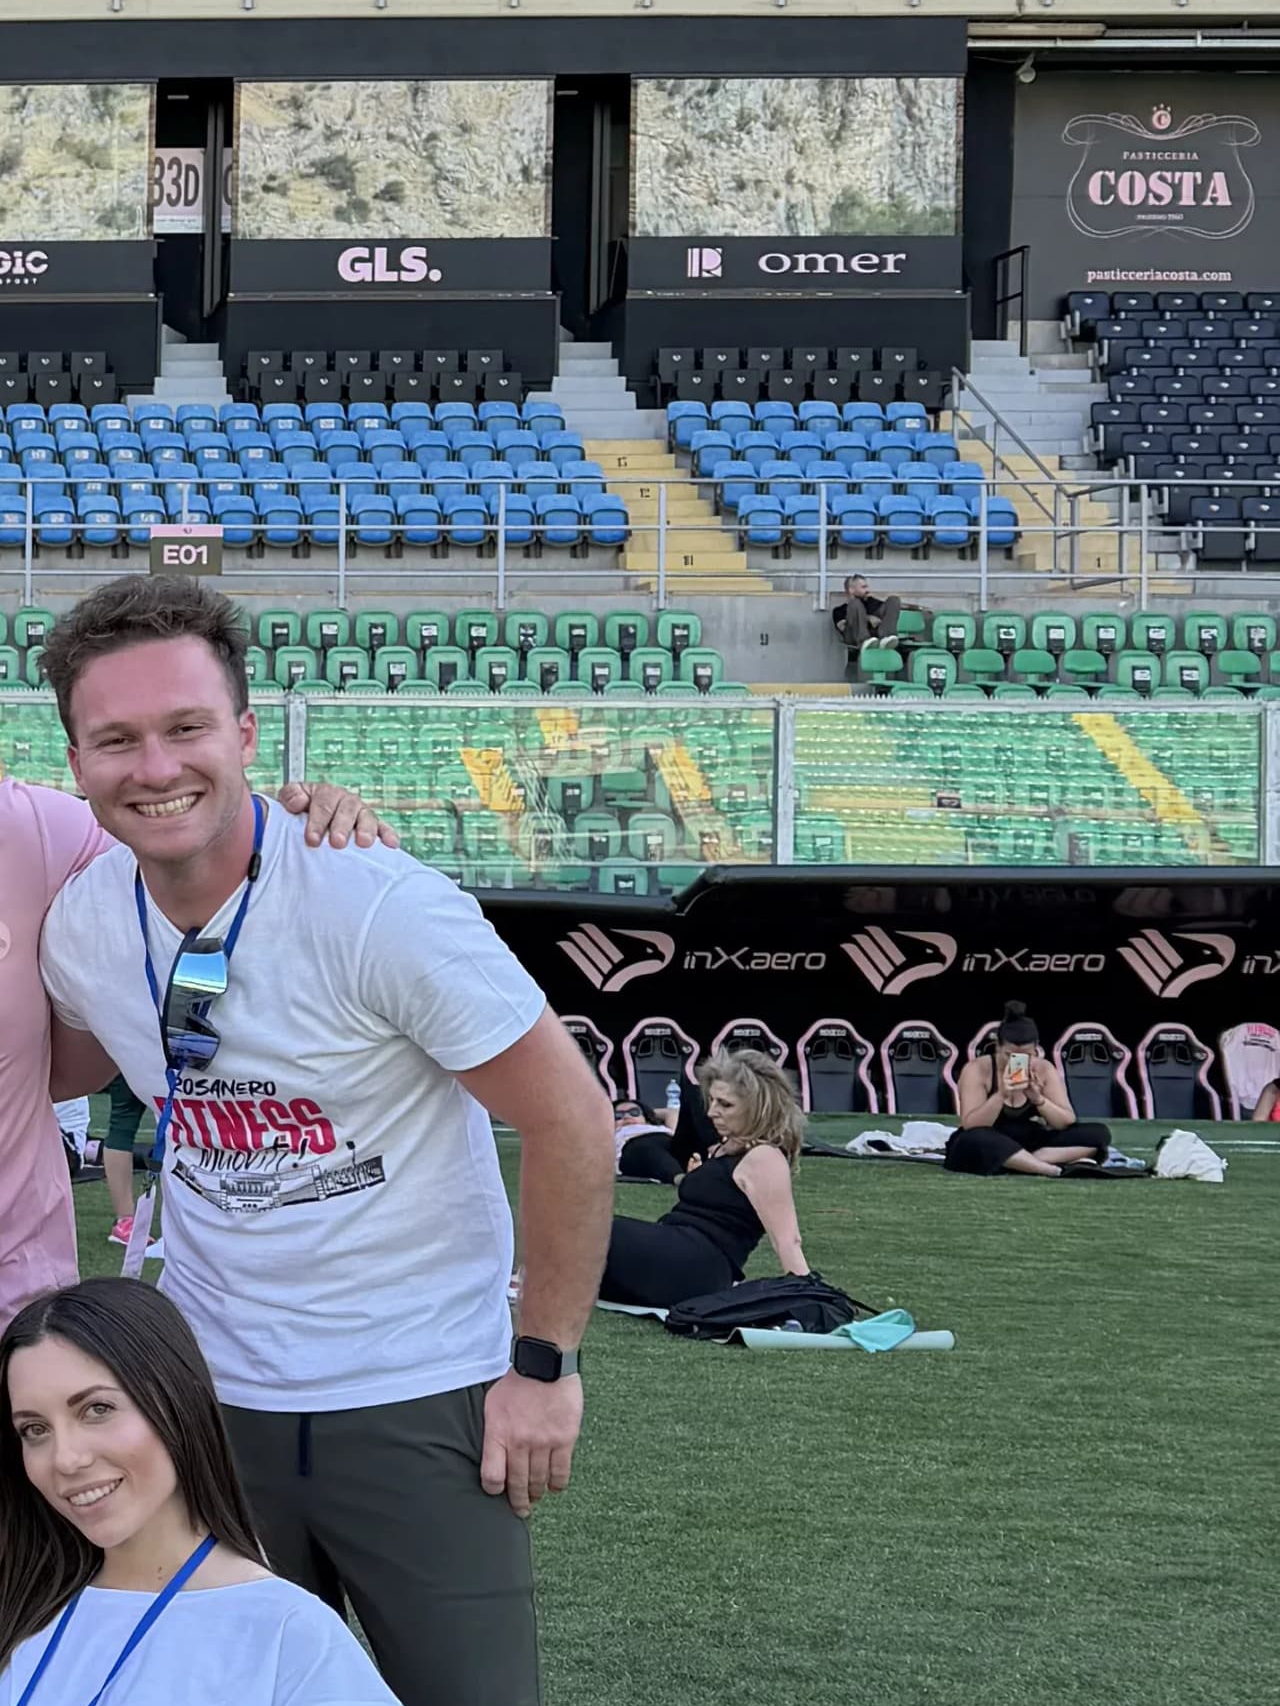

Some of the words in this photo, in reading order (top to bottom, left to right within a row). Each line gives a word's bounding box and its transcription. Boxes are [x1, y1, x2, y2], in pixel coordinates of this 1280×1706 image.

[1123, 152, 1199, 160] PASTICCERIA
[1088, 170, 1232, 206] COSTA
[758, 253, 907, 274] omer
[1087, 269, 1232, 282] pasticceriacosta.com
[163, 544, 208, 565] E01
